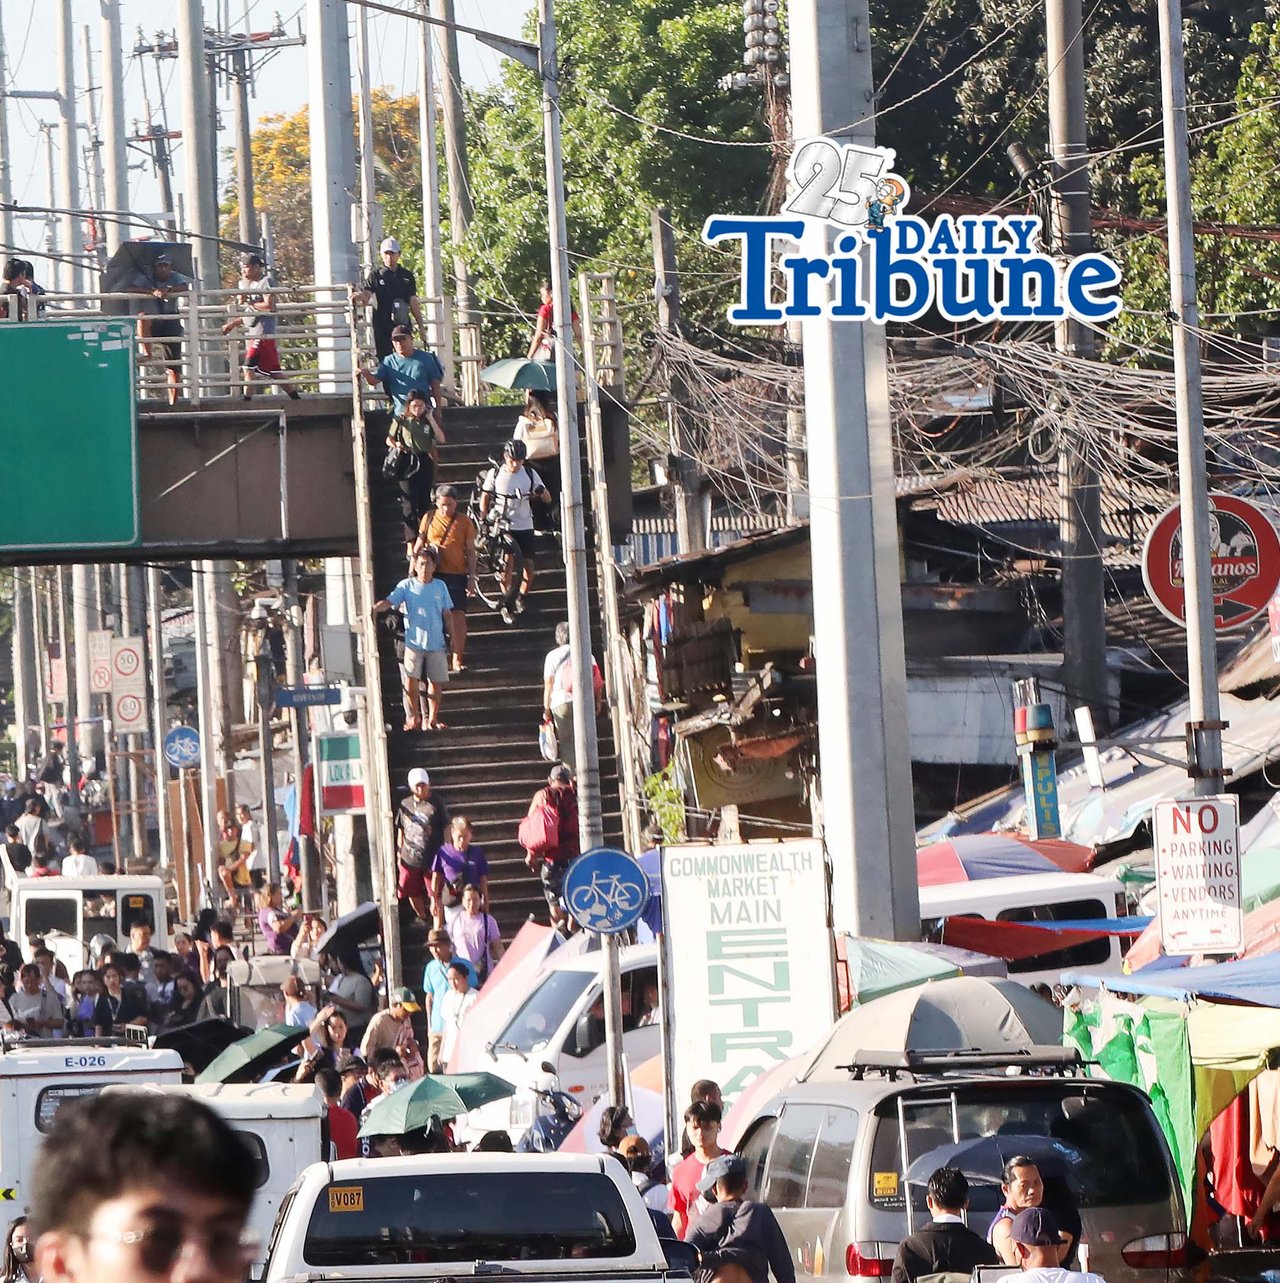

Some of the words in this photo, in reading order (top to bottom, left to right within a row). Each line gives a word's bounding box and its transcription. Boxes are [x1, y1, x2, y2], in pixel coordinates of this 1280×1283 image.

[1172, 804, 1218, 834] NO
[1170, 839, 1232, 858] PARKING
[670, 851, 813, 877] COMMONWEALTH
[1171, 862, 1234, 880] WAITING
[707, 876, 780, 899] MARKET
[1172, 884, 1235, 902] VENDORS
[710, 899, 782, 925] MAIN
[1173, 908, 1227, 921] ANYTIME
[64, 1056, 106, 1068] E-026
